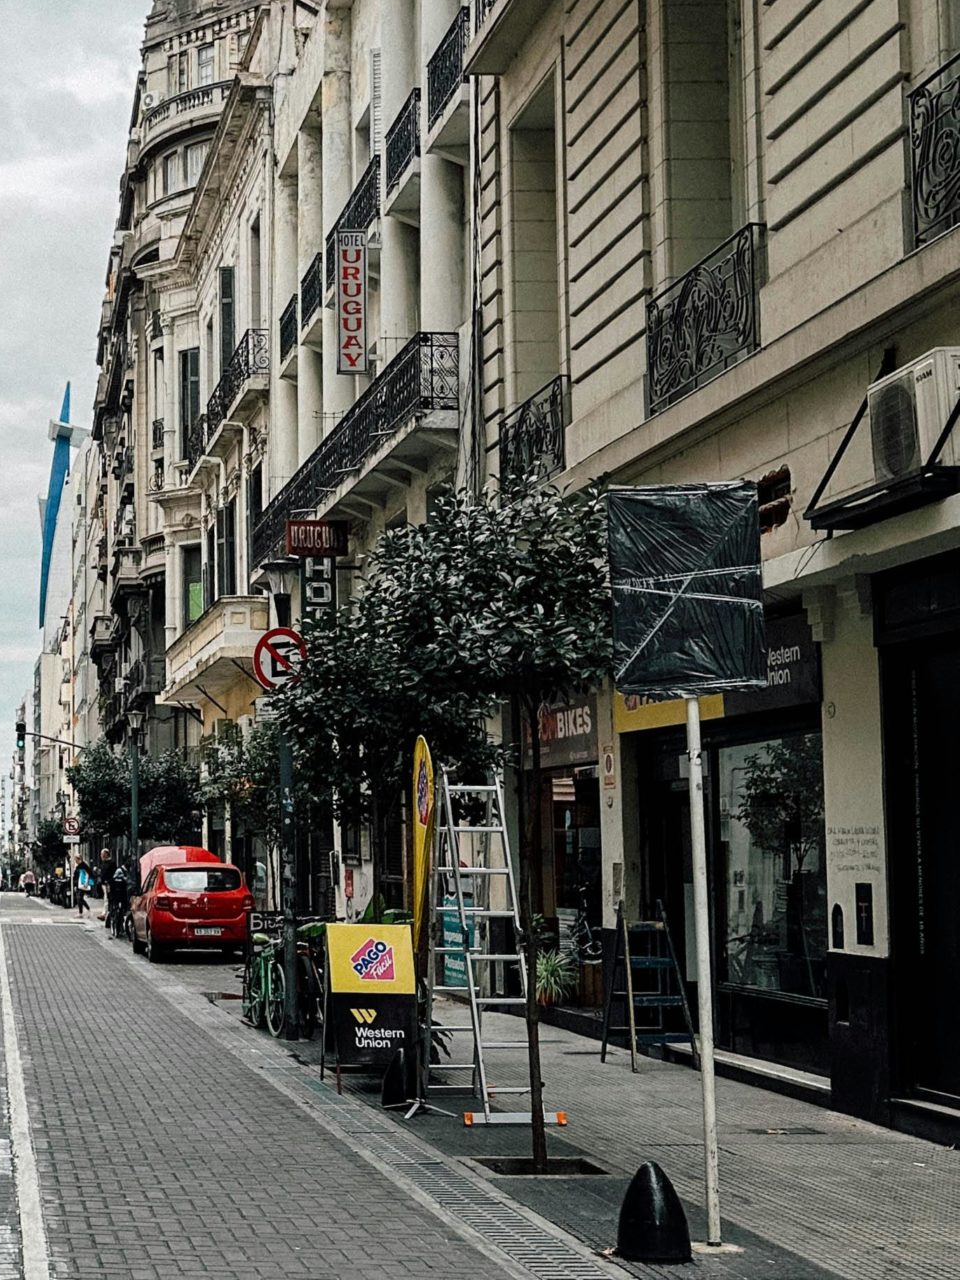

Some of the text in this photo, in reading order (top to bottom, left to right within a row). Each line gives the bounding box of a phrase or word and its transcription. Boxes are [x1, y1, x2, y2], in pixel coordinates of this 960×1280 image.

[339, 234, 365, 247] HOTEL
[342, 248, 364, 367] URUGUAY
[290, 525, 340, 549] URUGUA
[352, 940, 388, 976] PAGO
[354, 1026, 405, 1038] Western
[355, 1037, 391, 1049] Union
